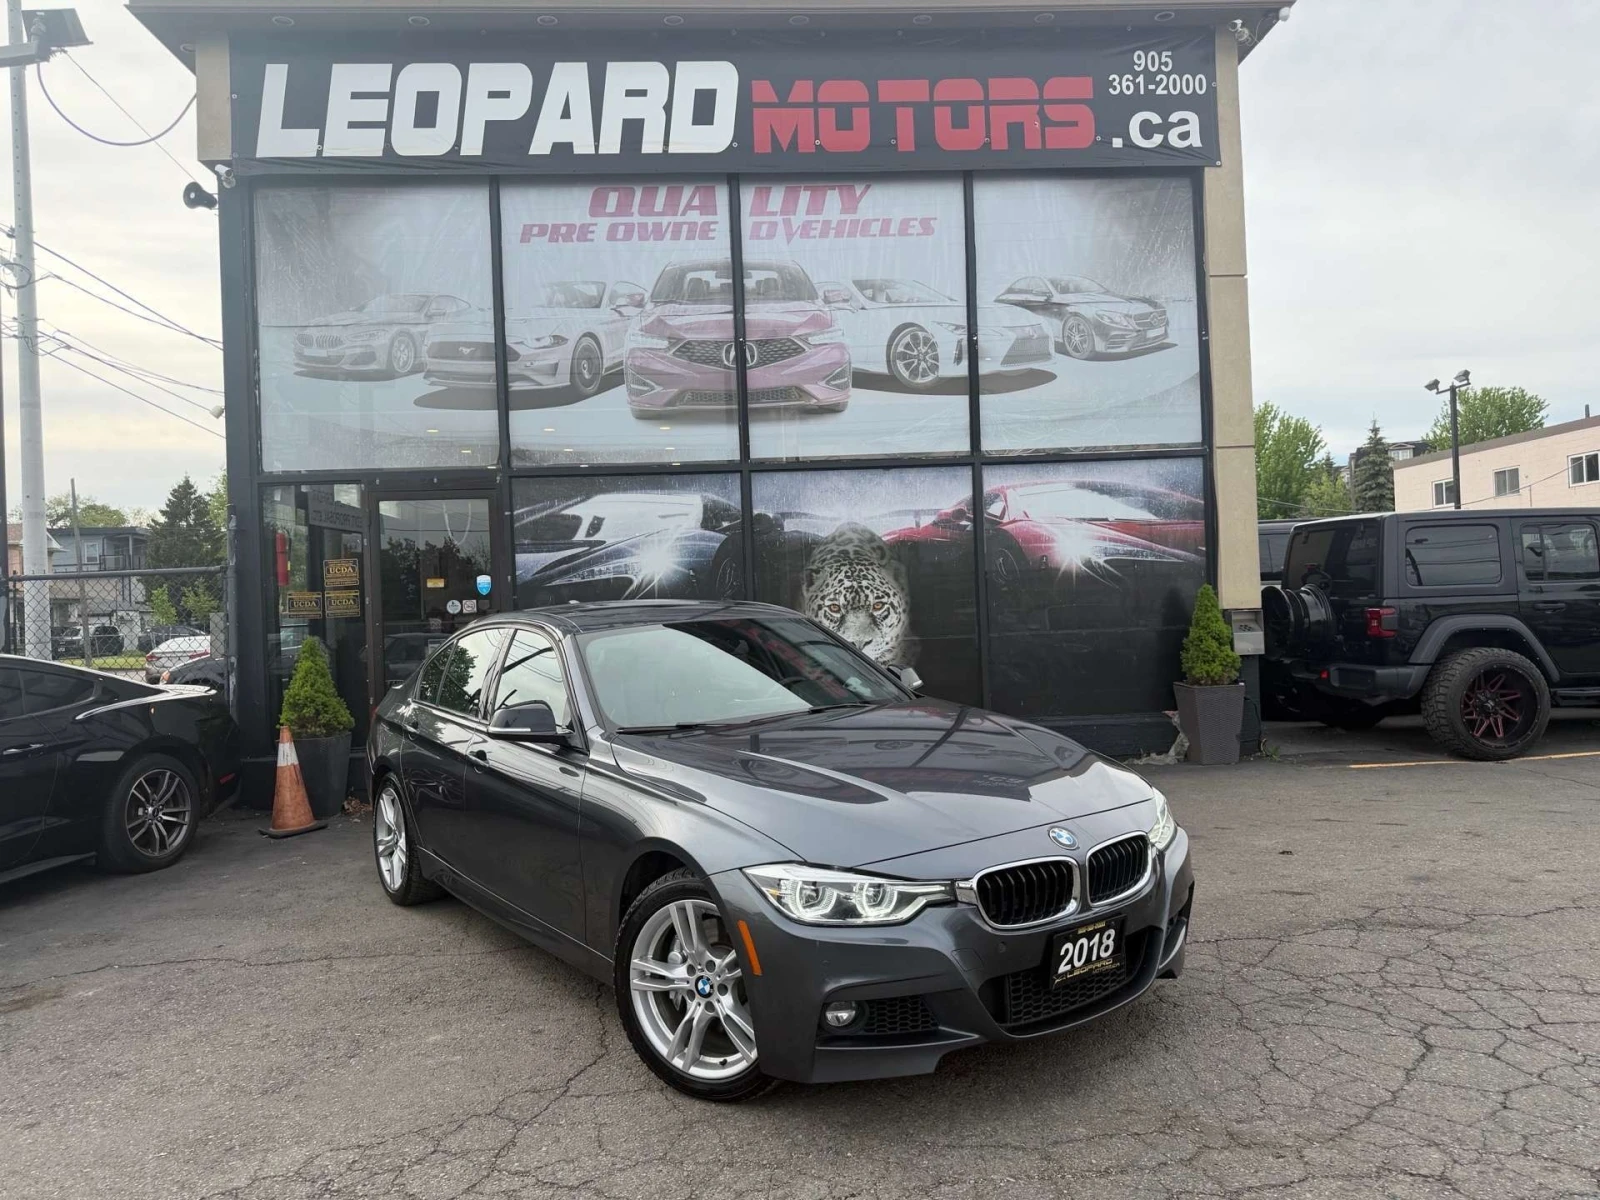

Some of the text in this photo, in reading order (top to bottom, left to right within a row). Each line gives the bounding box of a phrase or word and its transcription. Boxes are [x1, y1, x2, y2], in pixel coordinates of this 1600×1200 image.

[1133, 50, 1173, 73] 905
[1108, 74, 1208, 97] 361-2000
[256, 60, 1095, 157] LEOPARD MOTORS
[1111, 108, 1204, 149] .ca
[519, 222, 598, 243] PRE
[329, 566, 353, 574] UCDA
[1058, 928, 1116, 974] 2018
